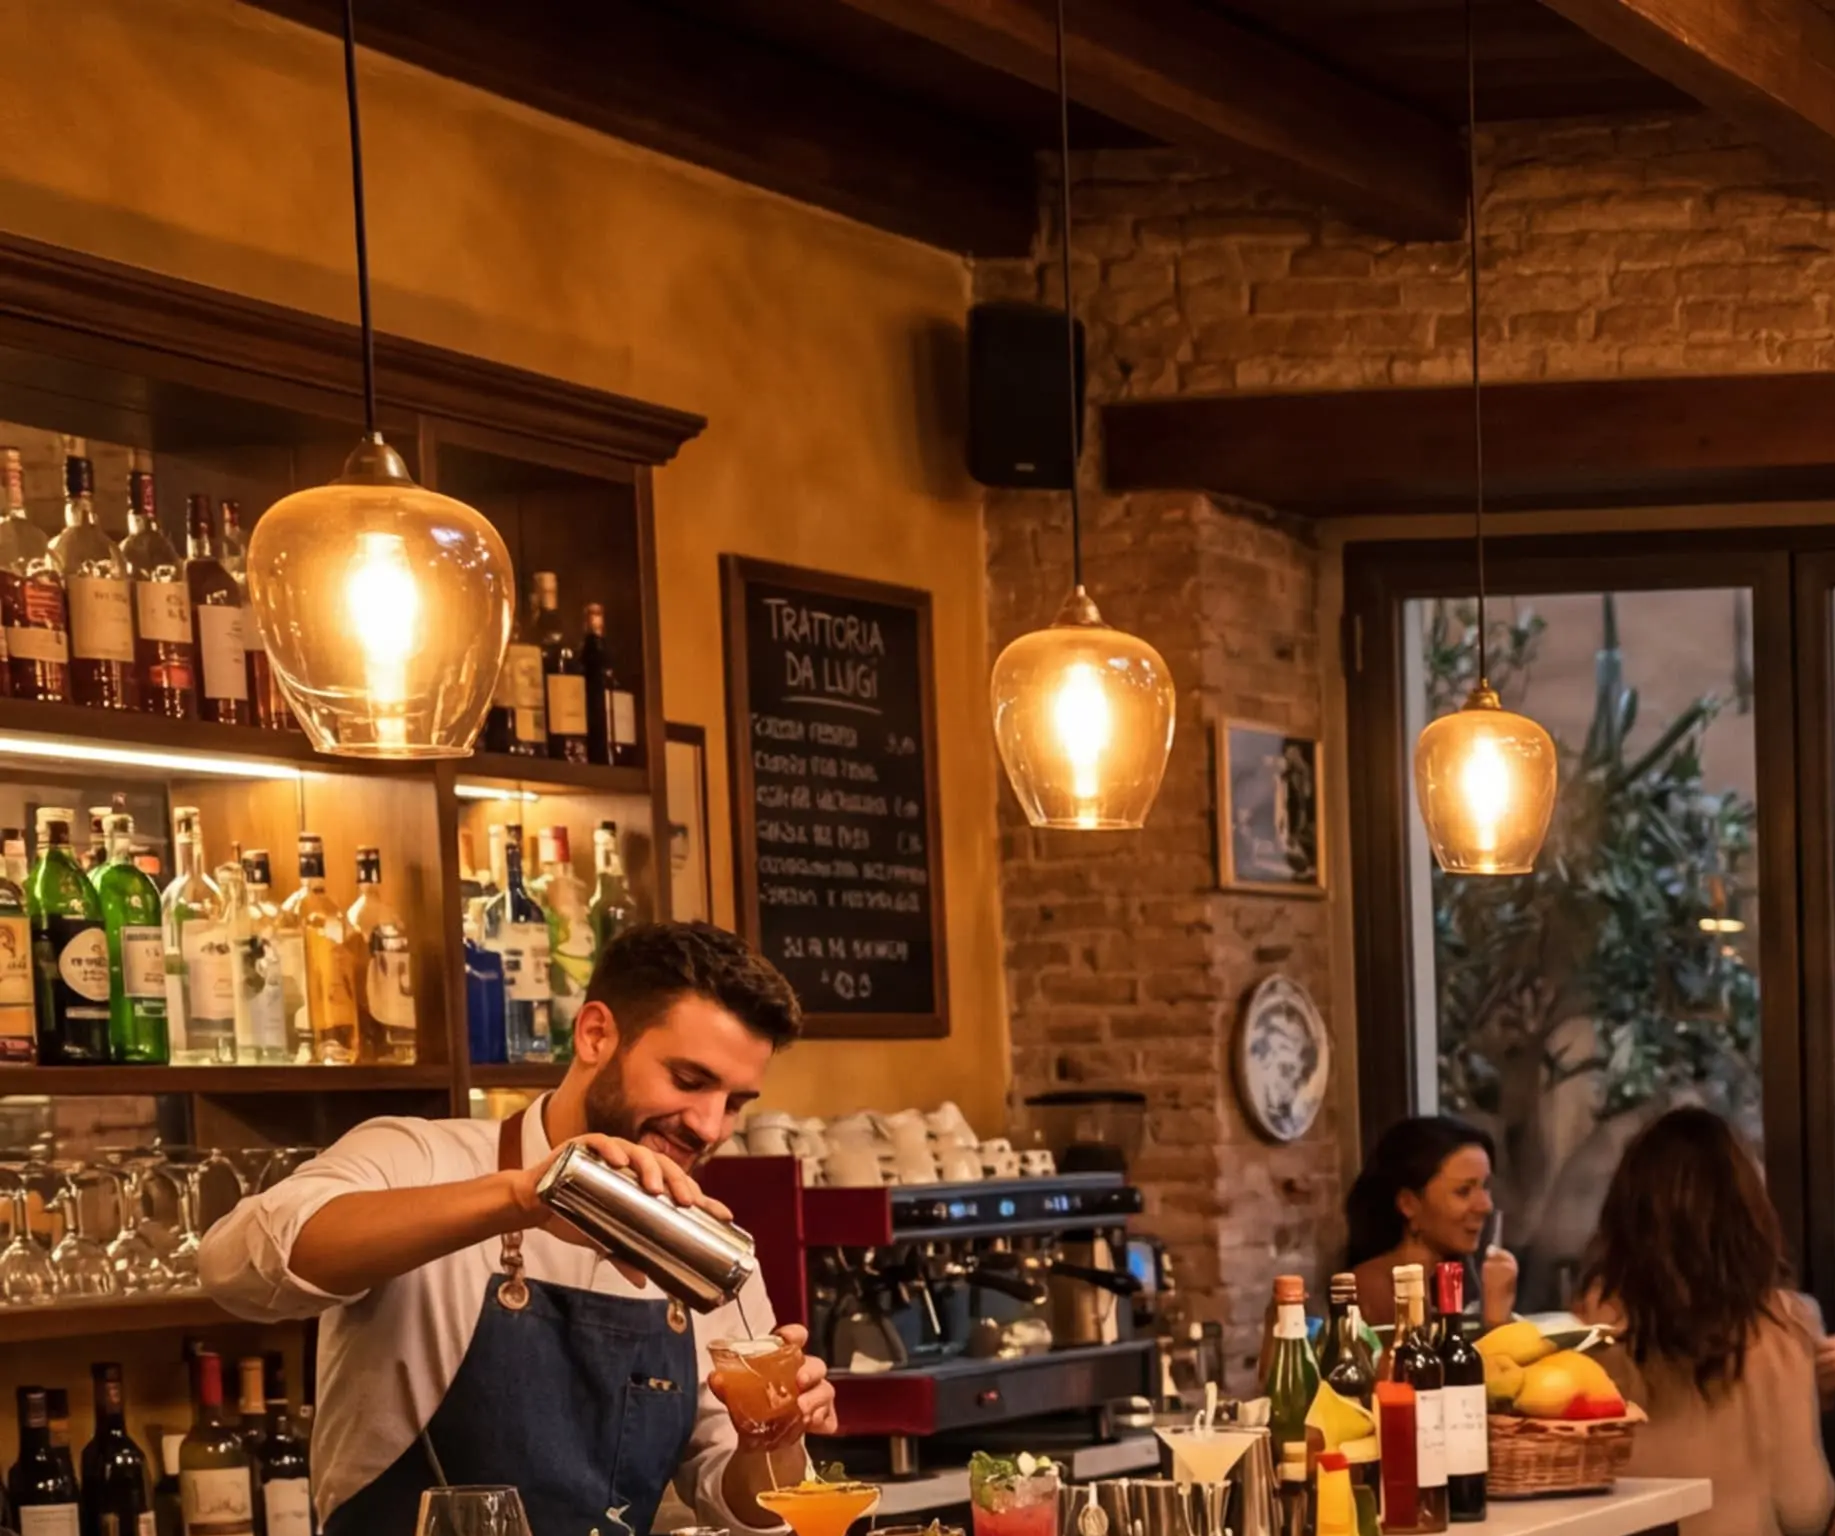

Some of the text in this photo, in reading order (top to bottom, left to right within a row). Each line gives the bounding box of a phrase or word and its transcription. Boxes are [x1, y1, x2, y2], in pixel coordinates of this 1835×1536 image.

[763, 598, 885, 656] TRATTORIA
[785, 650, 878, 699] DA LUIGI
